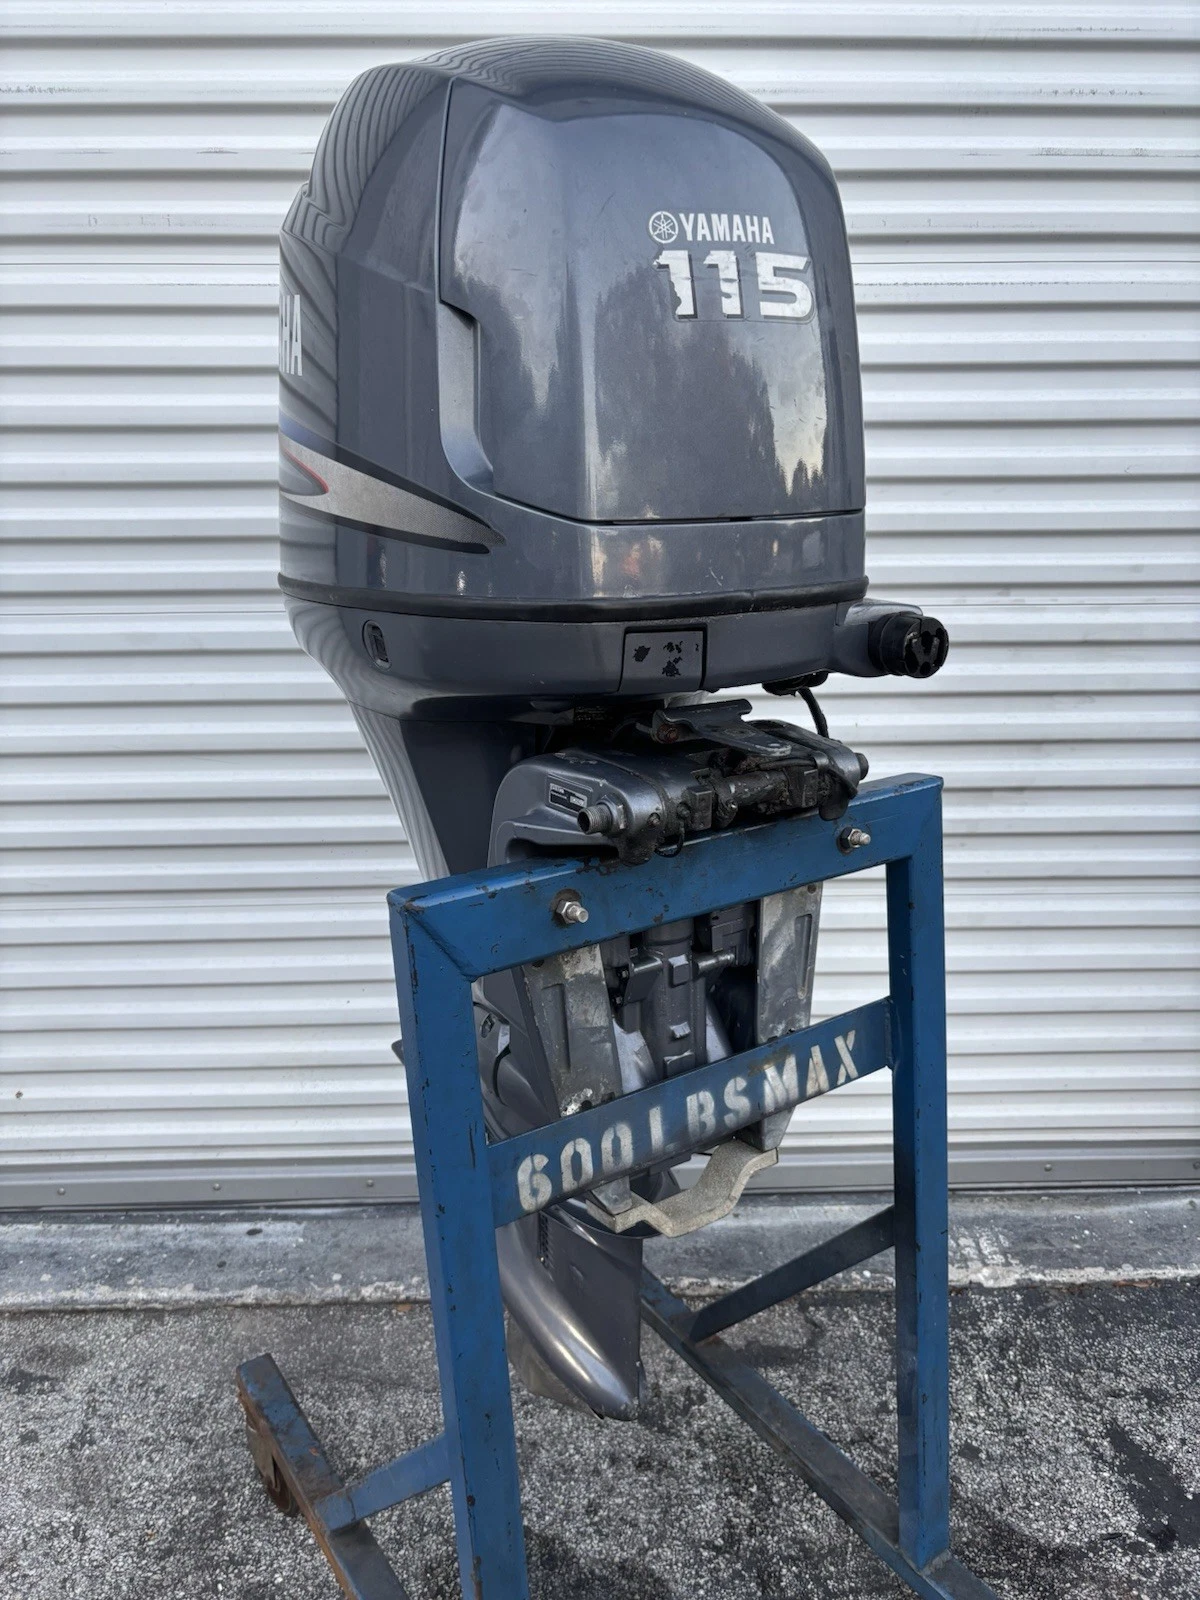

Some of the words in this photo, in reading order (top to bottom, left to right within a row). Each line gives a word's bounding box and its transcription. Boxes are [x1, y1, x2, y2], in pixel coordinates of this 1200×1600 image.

[678, 213, 775, 245] YAMAHA
[653, 250, 814, 319] 115
[279, 293, 303, 377] HA
[517, 1121, 634, 1212] 600
[762, 1030, 859, 1113] MAX
